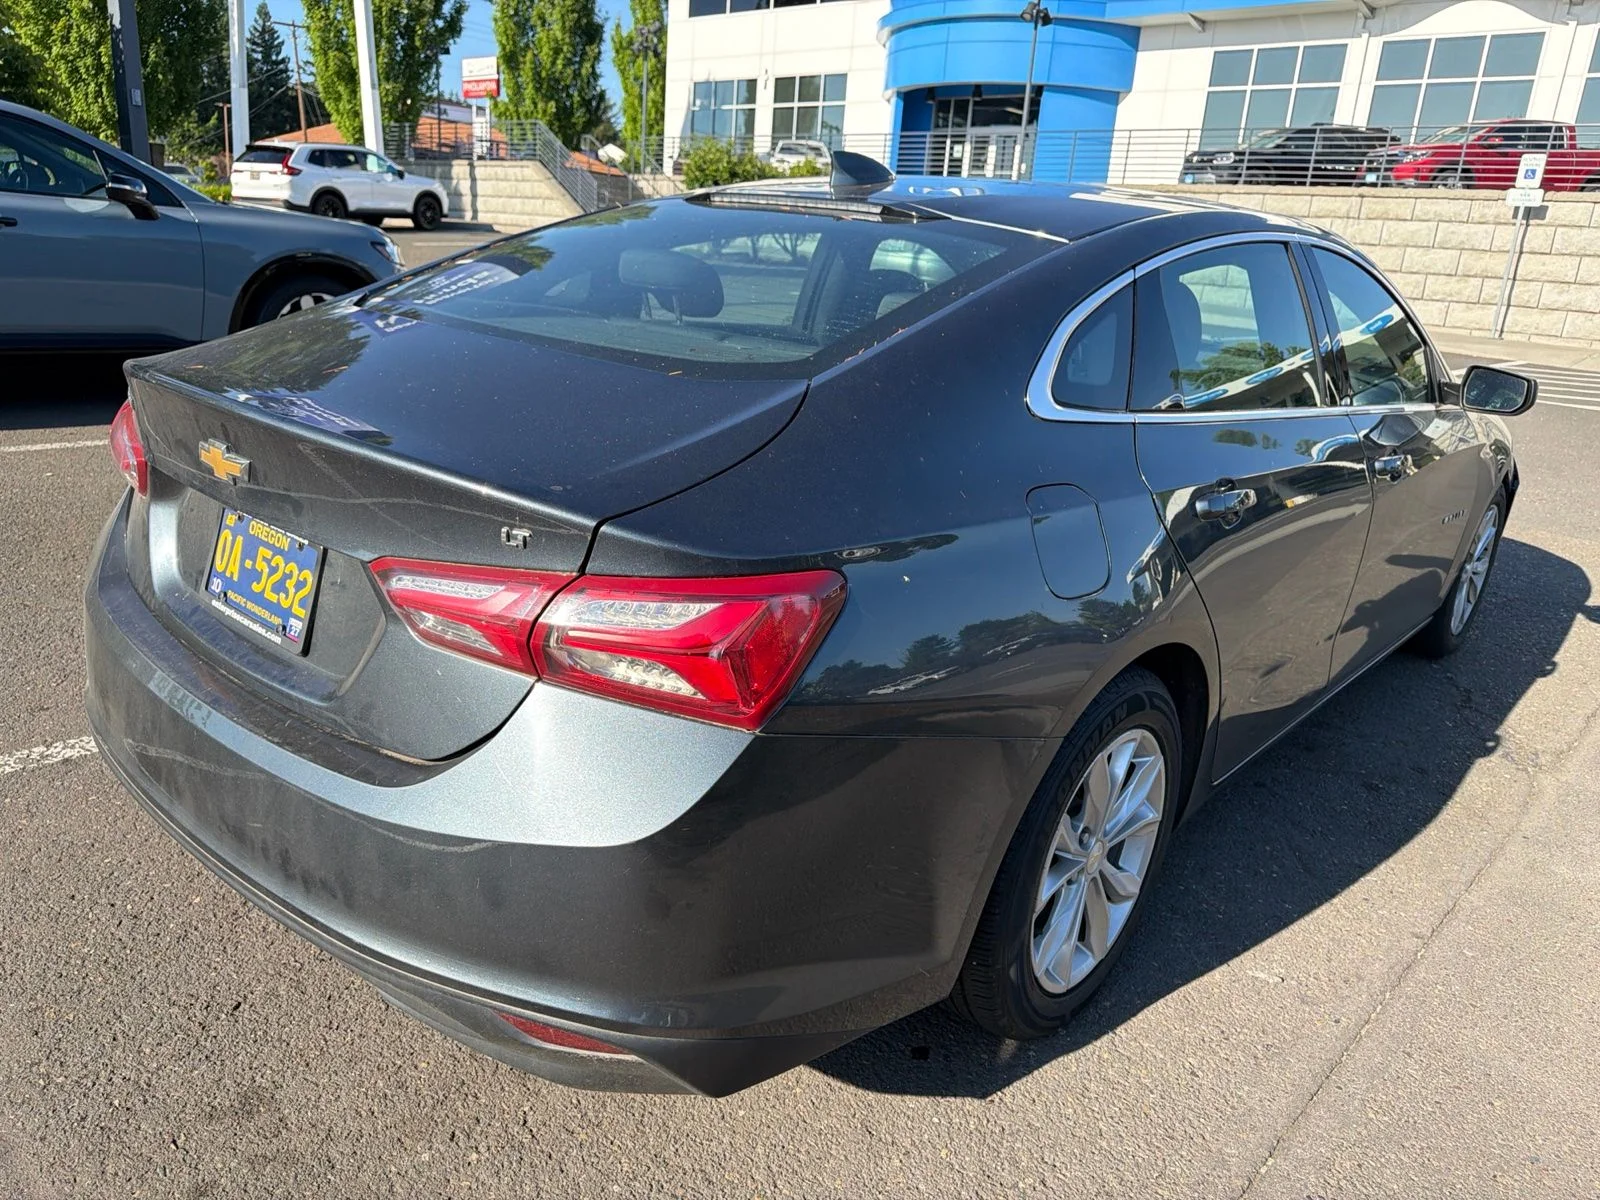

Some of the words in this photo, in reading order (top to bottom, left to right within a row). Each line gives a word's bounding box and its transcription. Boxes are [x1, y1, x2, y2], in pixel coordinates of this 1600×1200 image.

[249, 520, 290, 551] OREGON
[501, 526, 533, 549] LT
[211, 577, 222, 593] 10
[227, 590, 246, 607] PACIFIC
[245, 599, 282, 625] WONDERLAND
[211, 599, 282, 644] enterprisecarsales.com
[290, 625, 300, 637] 27
